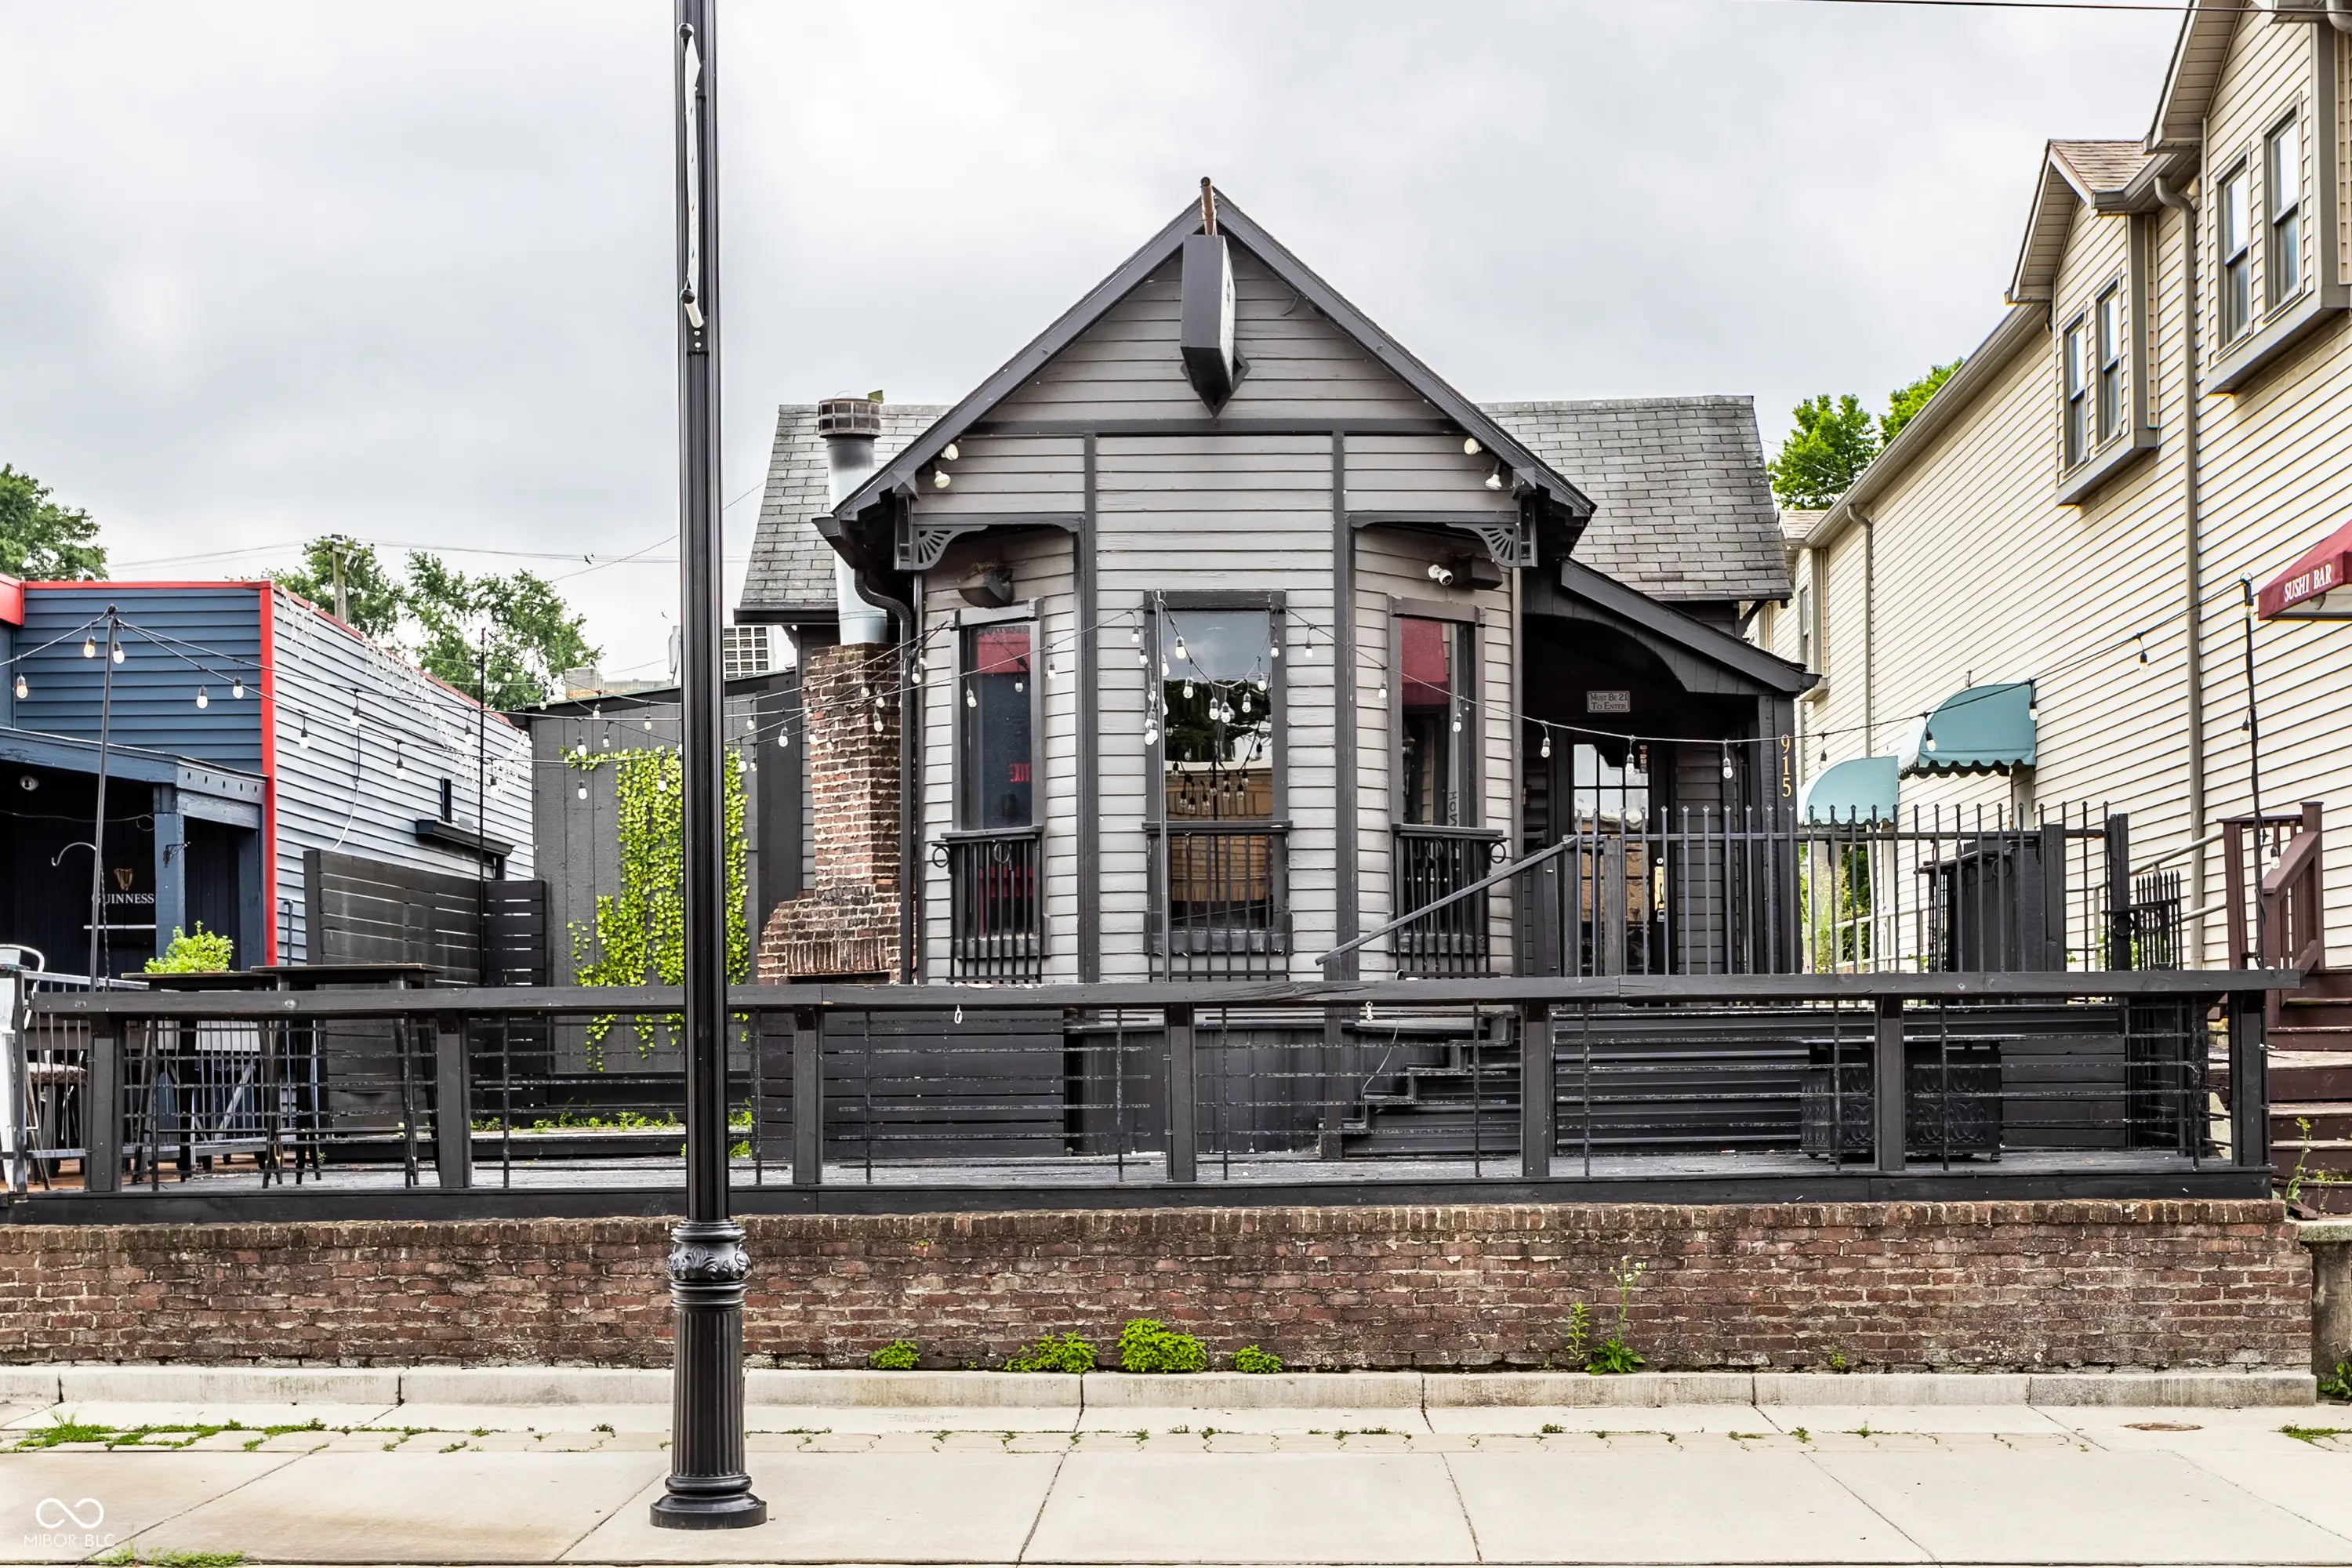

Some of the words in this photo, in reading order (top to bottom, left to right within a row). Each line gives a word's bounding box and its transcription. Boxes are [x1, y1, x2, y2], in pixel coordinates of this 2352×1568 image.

[2284, 572, 2310, 603] SUSHI
[2313, 563, 2332, 590] BAR
[1780, 734, 1791, 797] 915
